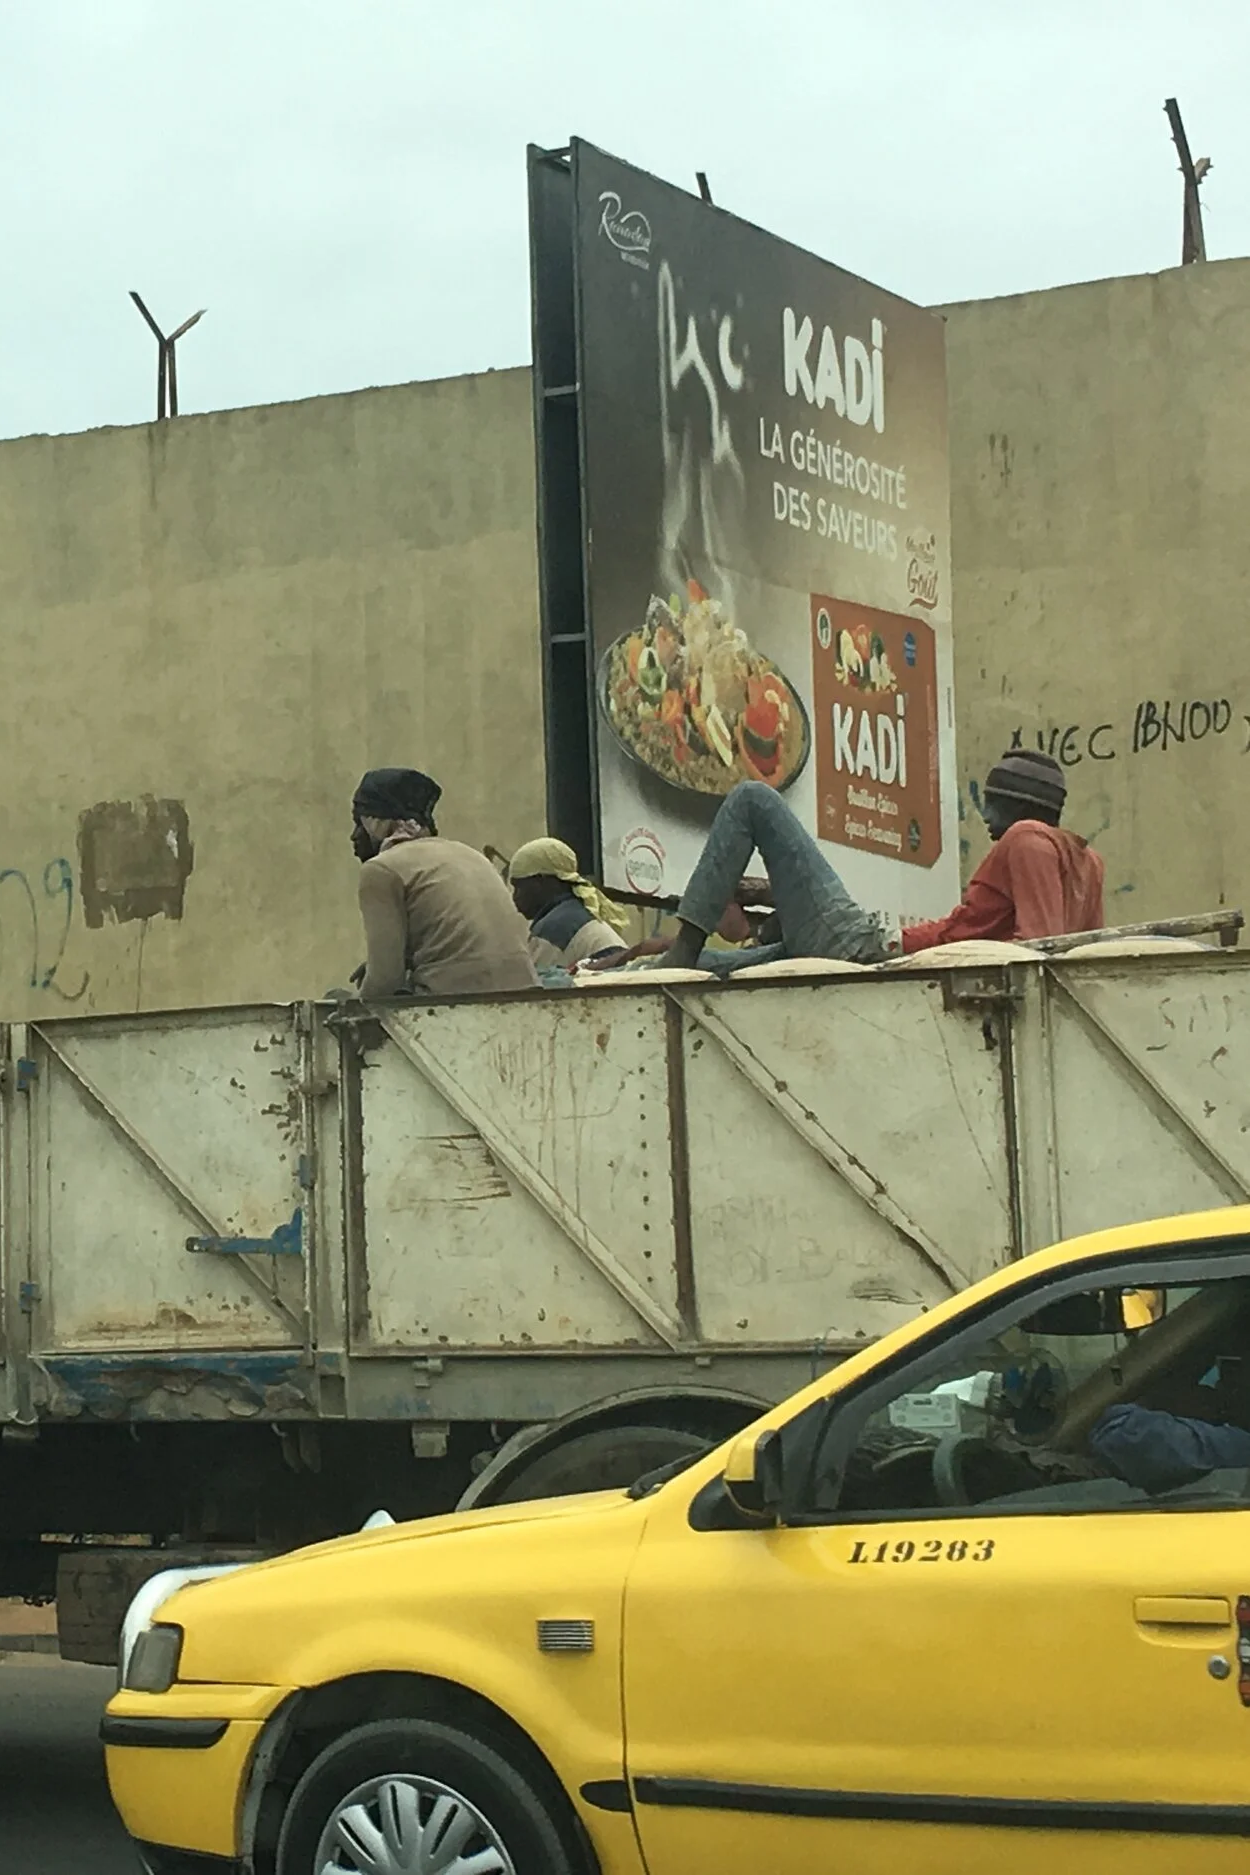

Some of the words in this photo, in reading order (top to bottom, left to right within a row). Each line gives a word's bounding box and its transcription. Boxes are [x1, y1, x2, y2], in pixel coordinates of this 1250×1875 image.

[759, 417, 785, 464] LA
[790, 428, 907, 509] GÉNÉROSITÉ
[773, 481, 812, 531] DES
[817, 497, 898, 562] SAVEURS
[847, 1539, 995, 1564] L19283
